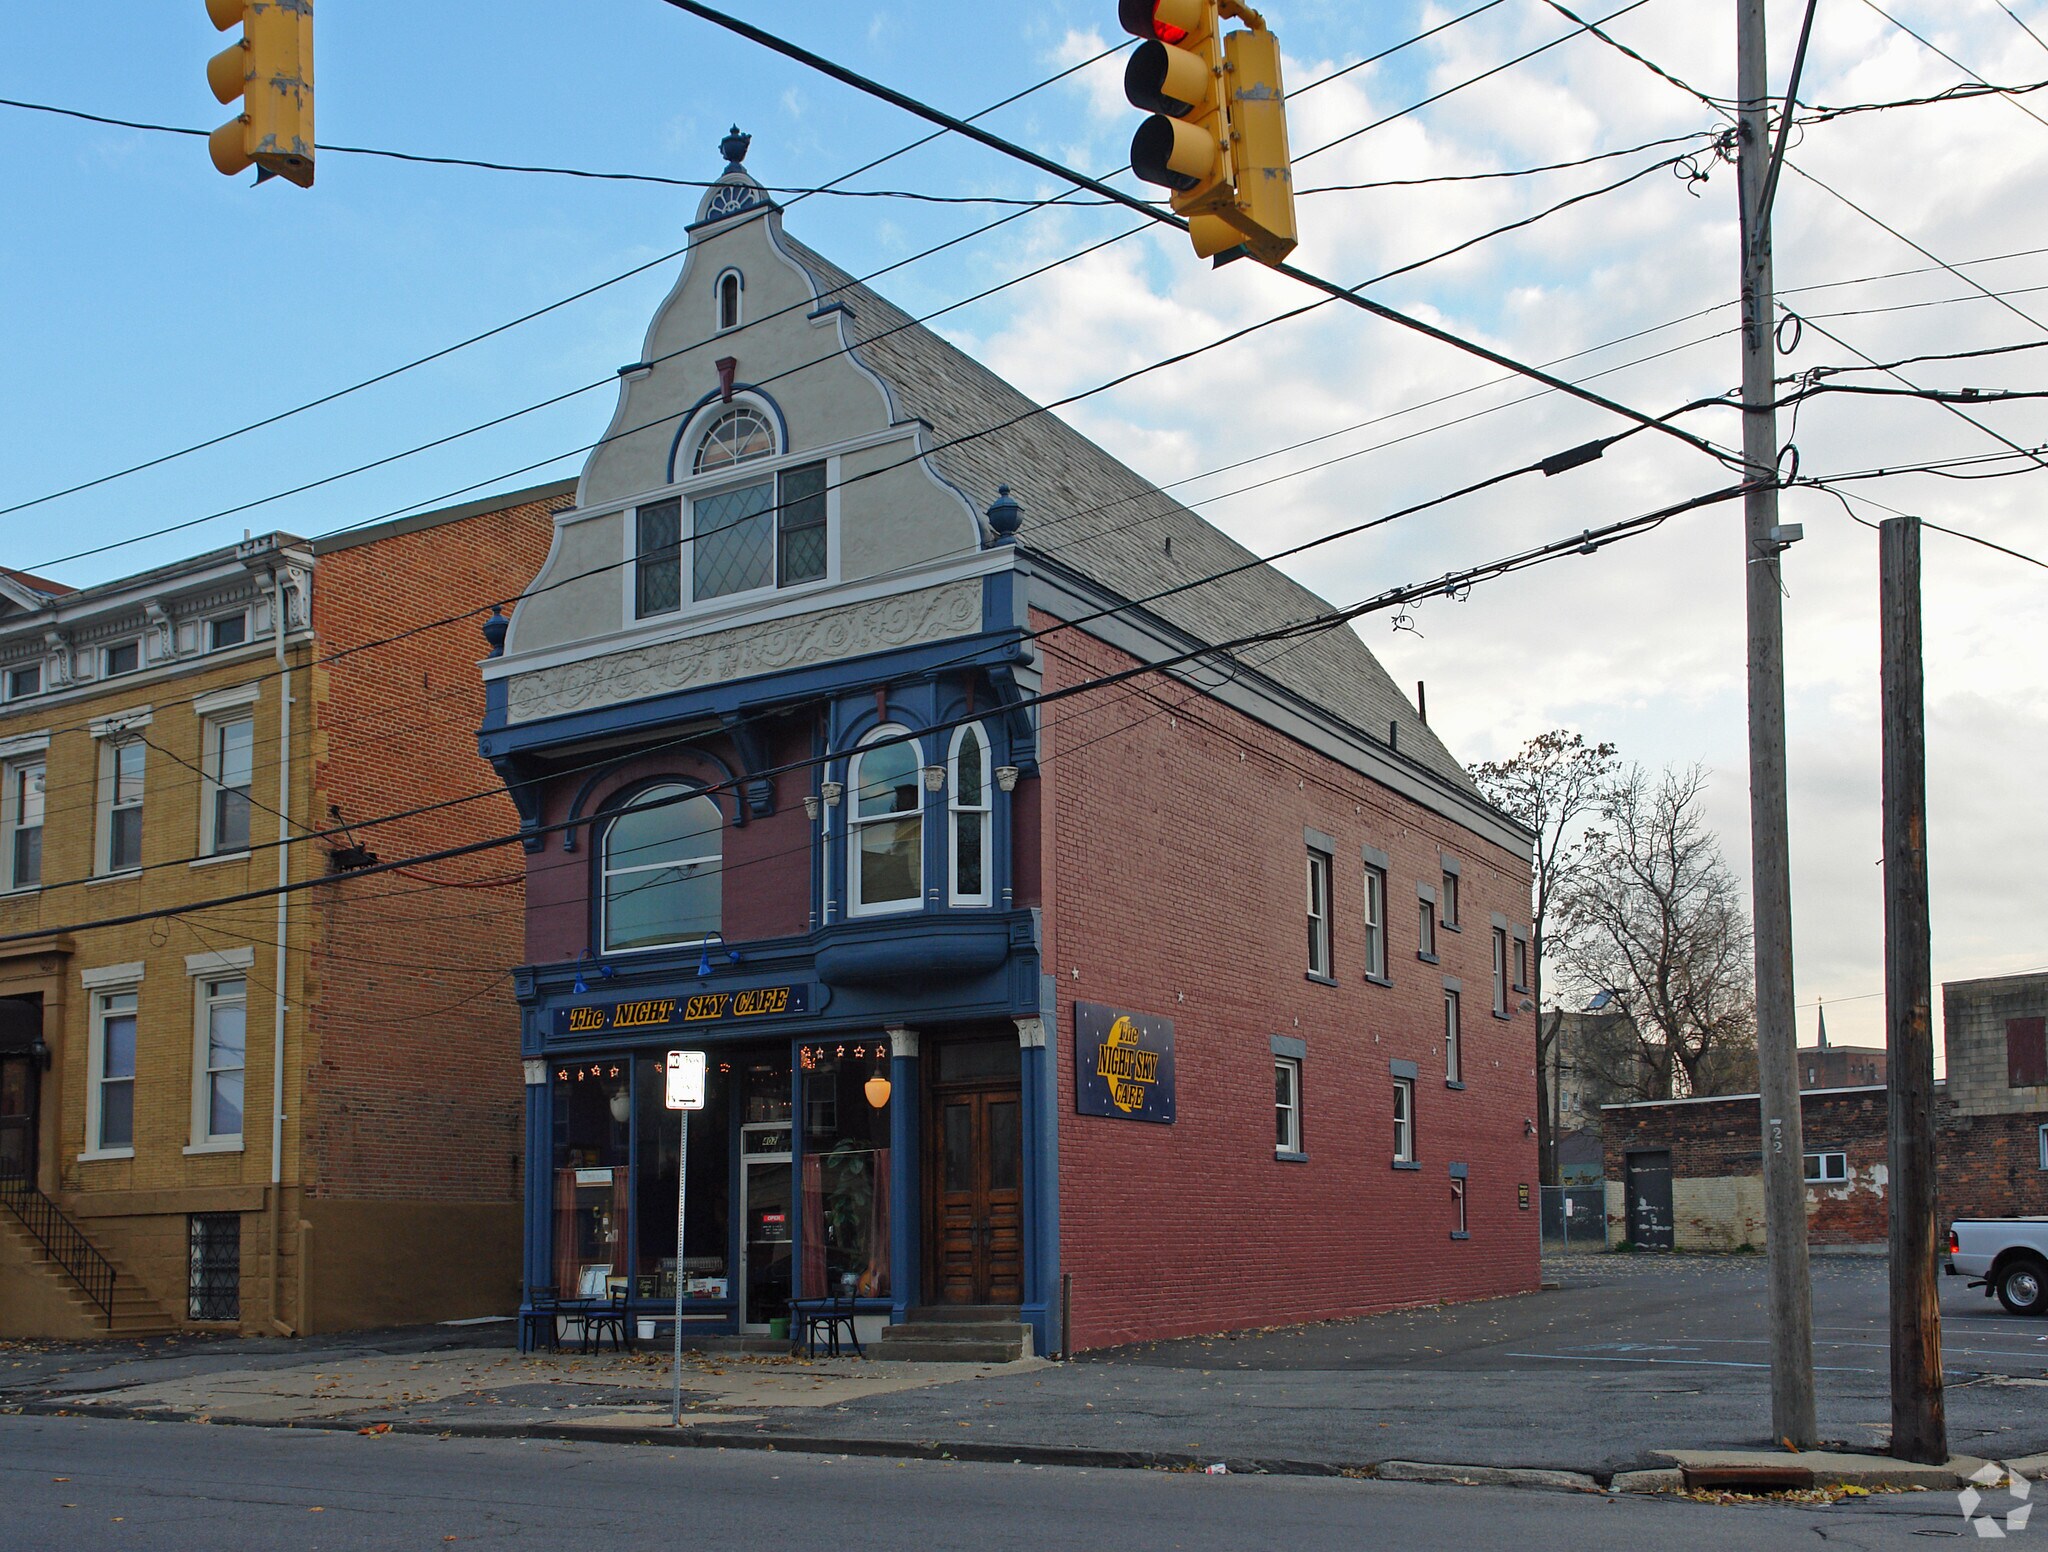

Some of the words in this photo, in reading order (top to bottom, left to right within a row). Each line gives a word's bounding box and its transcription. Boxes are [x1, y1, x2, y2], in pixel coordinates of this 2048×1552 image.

[570, 1007, 605, 1031] The
[613, 999, 676, 1028] NIGHT
[684, 993, 729, 1021] SKY
[733, 986, 790, 1016] CAFE
[1118, 1021, 1139, 1046] The
[1096, 1043, 1135, 1080] NIGHT
[1134, 1049, 1158, 1083] SKY
[1113, 1081, 1144, 1109] CAFE
[1772, 1127, 1783, 1153] 22
